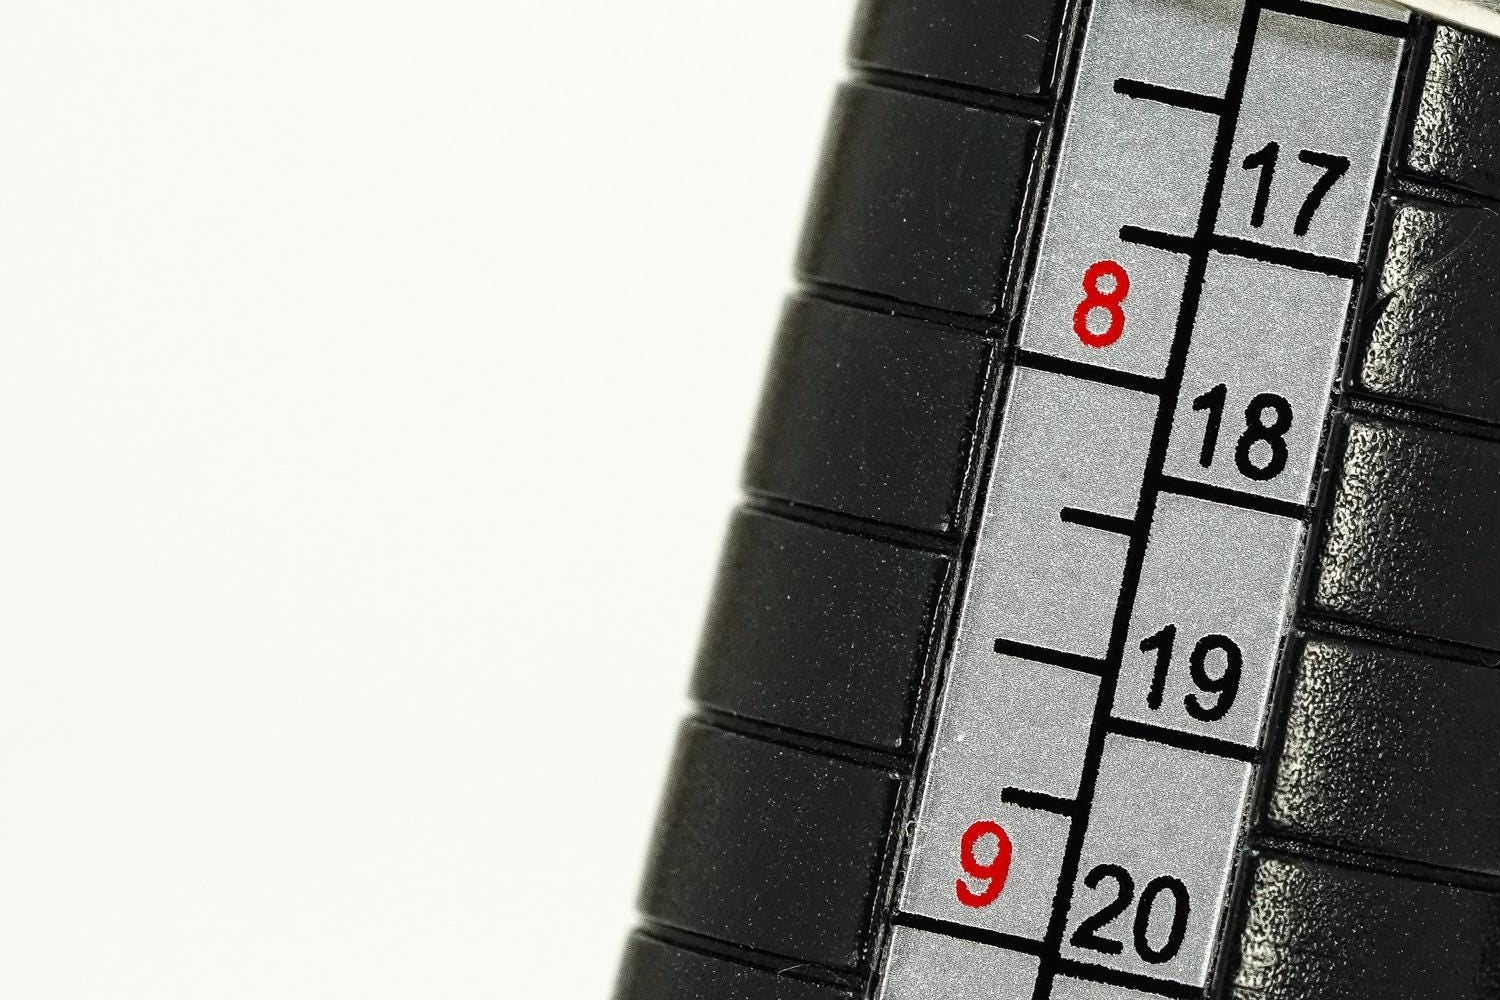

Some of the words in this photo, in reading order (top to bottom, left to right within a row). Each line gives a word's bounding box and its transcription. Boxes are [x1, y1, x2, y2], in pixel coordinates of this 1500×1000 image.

[1241, 140, 1351, 238] 17
[1072, 259, 1131, 349] 8
[1191, 383, 1294, 482] 18
[1139, 623, 1244, 723] 19
[955, 820, 1013, 909] 9
[1069, 863, 1192, 965] 20
